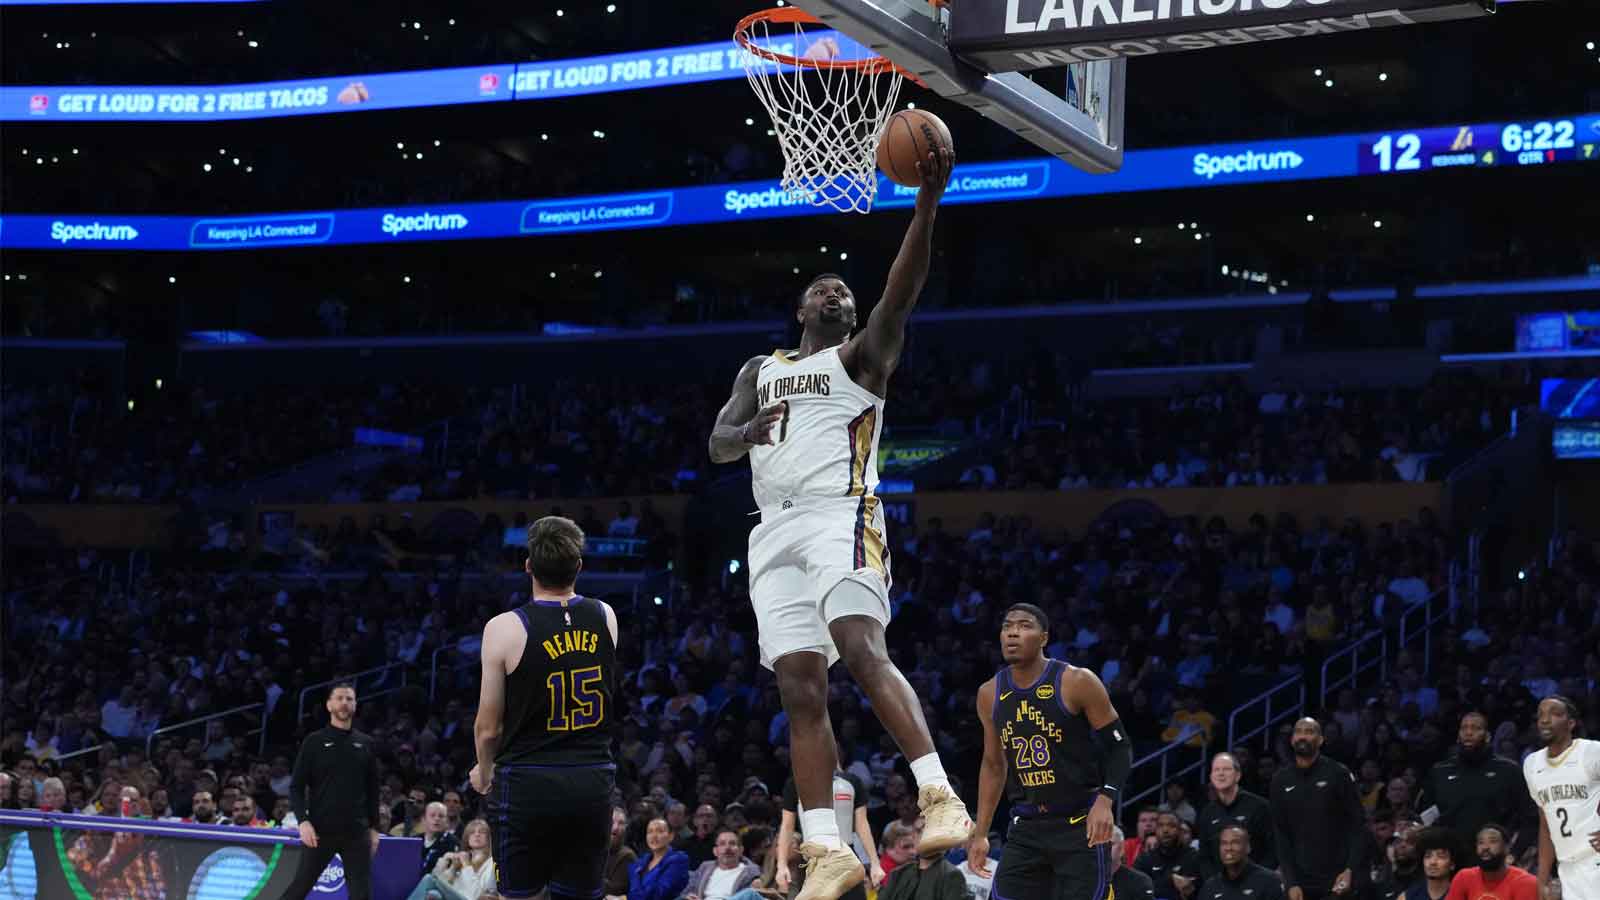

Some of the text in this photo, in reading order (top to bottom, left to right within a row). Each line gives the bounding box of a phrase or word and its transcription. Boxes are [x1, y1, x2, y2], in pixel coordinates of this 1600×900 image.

[508, 73, 551, 91] GET
[553, 67, 608, 87] LOUD
[610, 59, 653, 82] FOR
[655, 57, 669, 76] 2
[671, 50, 723, 74] FREE
[58, 86, 329, 112] GET LOUD FOR 2 FREE TACOS
[1502, 120, 1575, 152] 6:22
[1372, 135, 1421, 171] 12
[1482, 151, 1494, 165] 4
[1583, 144, 1594, 158] 7
[1193, 151, 1297, 179] Spectrum
[961, 173, 1029, 191] Connected
[538, 202, 655, 224] Keeping LA Connected
[724, 187, 812, 214] Spectrum
[50, 221, 134, 244] Spectrum
[248, 226, 262, 238] LA
[263, 222, 317, 237] Connected
[382, 214, 464, 235] Spectrum
[774, 374, 830, 399] ORLEANS
[542, 630, 598, 660] REAVES
[547, 665, 604, 731] 15
[1000, 700, 1062, 750] LOS ANGELES
[1011, 735, 1051, 769] 28
[1018, 770, 1055, 787] LAKERS
[1551, 784, 1589, 801] ORLEANS
[1556, 807, 1572, 838] 2
